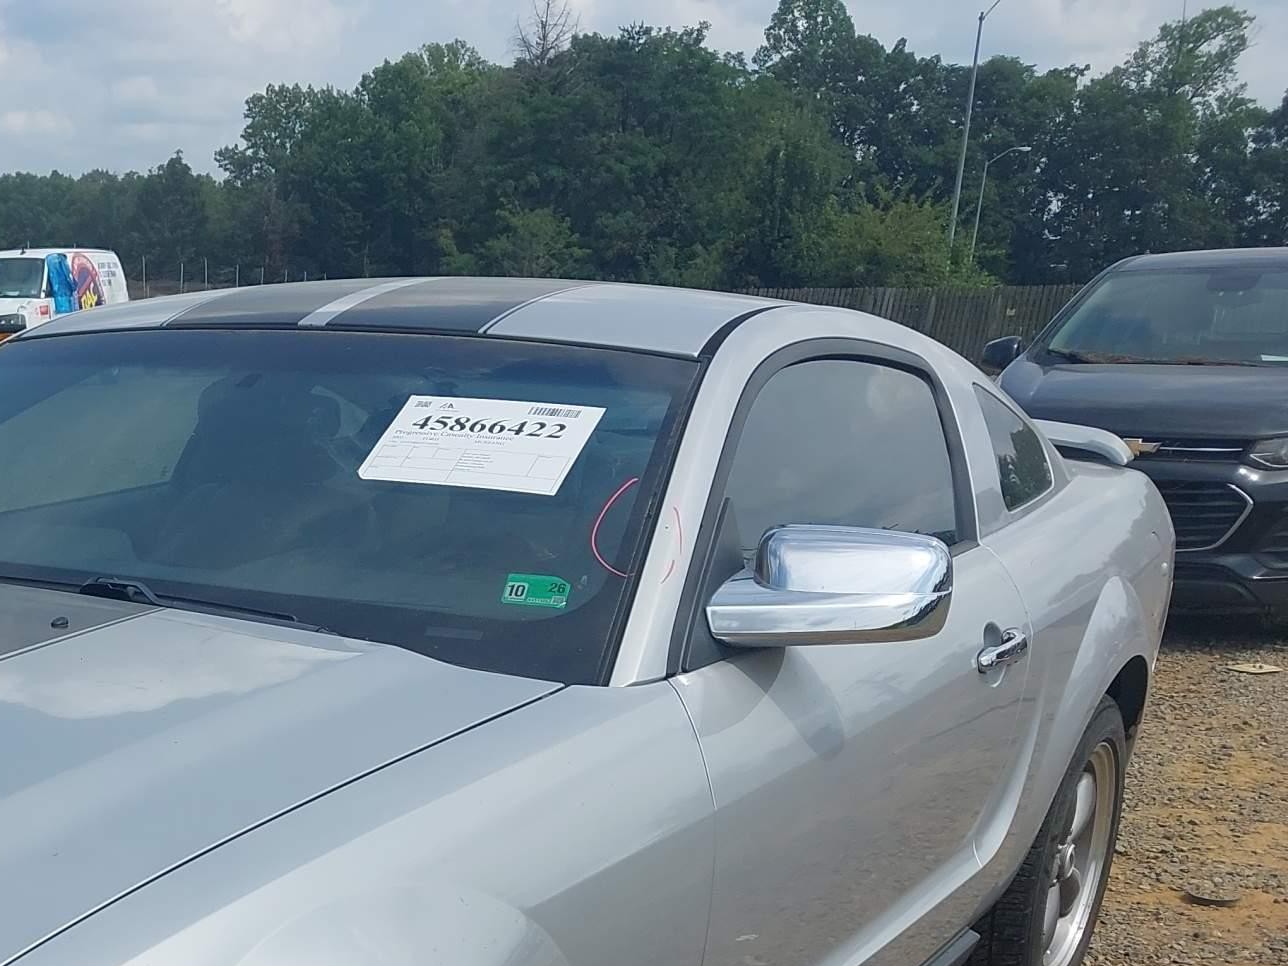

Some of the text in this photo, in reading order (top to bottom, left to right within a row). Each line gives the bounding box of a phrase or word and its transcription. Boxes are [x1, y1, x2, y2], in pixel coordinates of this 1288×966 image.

[412, 415, 567, 439] 45866422
[508, 584, 526, 597] 10
[547, 583, 567, 593] 26
